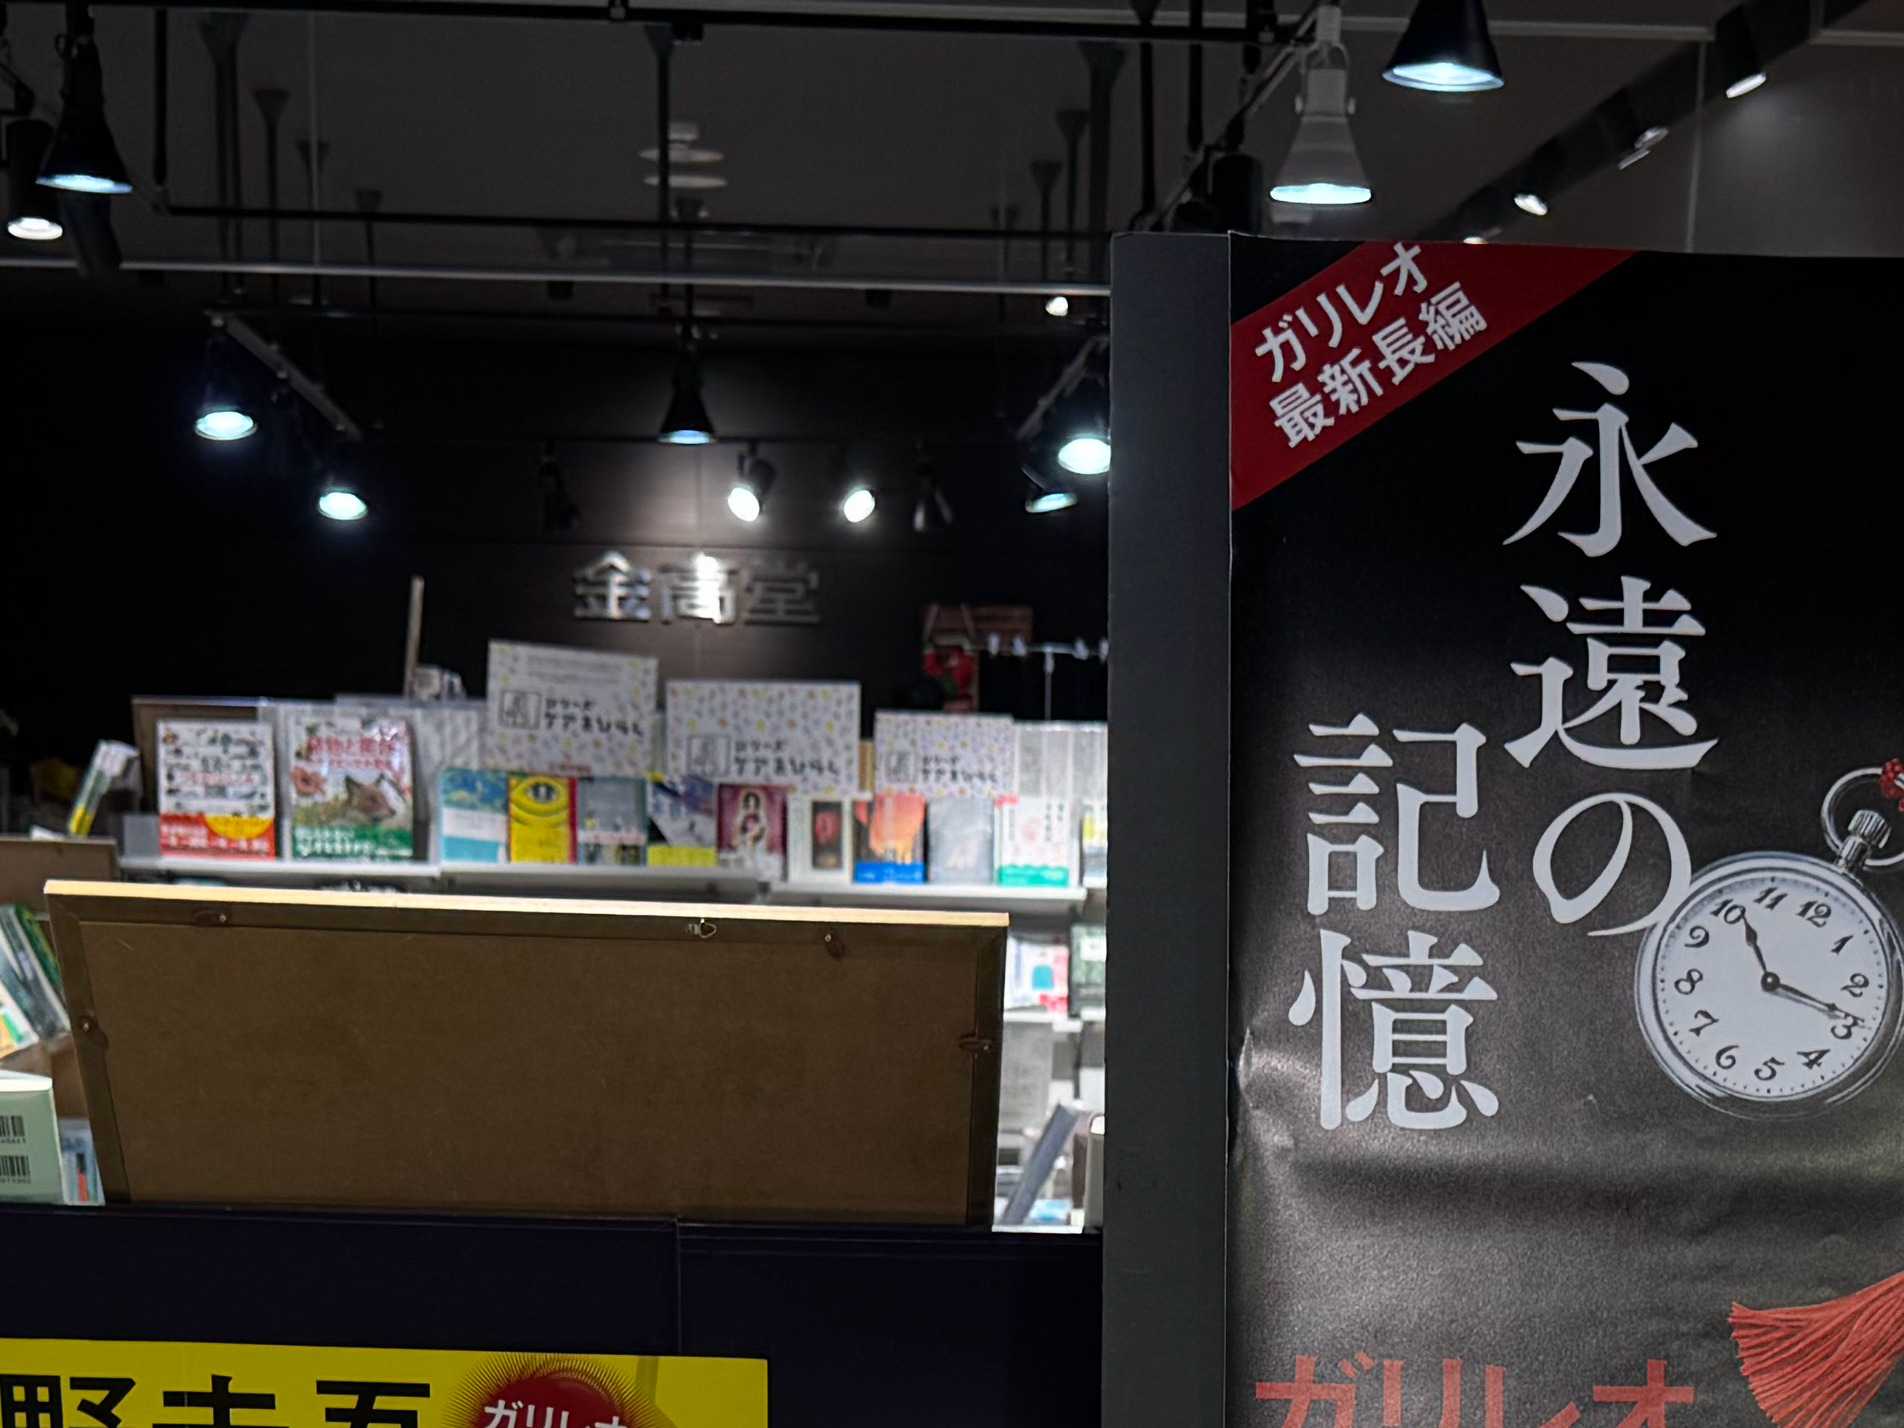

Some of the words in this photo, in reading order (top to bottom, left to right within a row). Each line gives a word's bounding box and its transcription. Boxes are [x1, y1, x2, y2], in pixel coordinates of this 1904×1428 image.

[1255, 239, 1433, 384] ガリレオ
[1268, 284, 1486, 452] 最新長編
[1503, 362, 1719, 935] 永遠の
[1290, 712, 1500, 1130] 記憶
